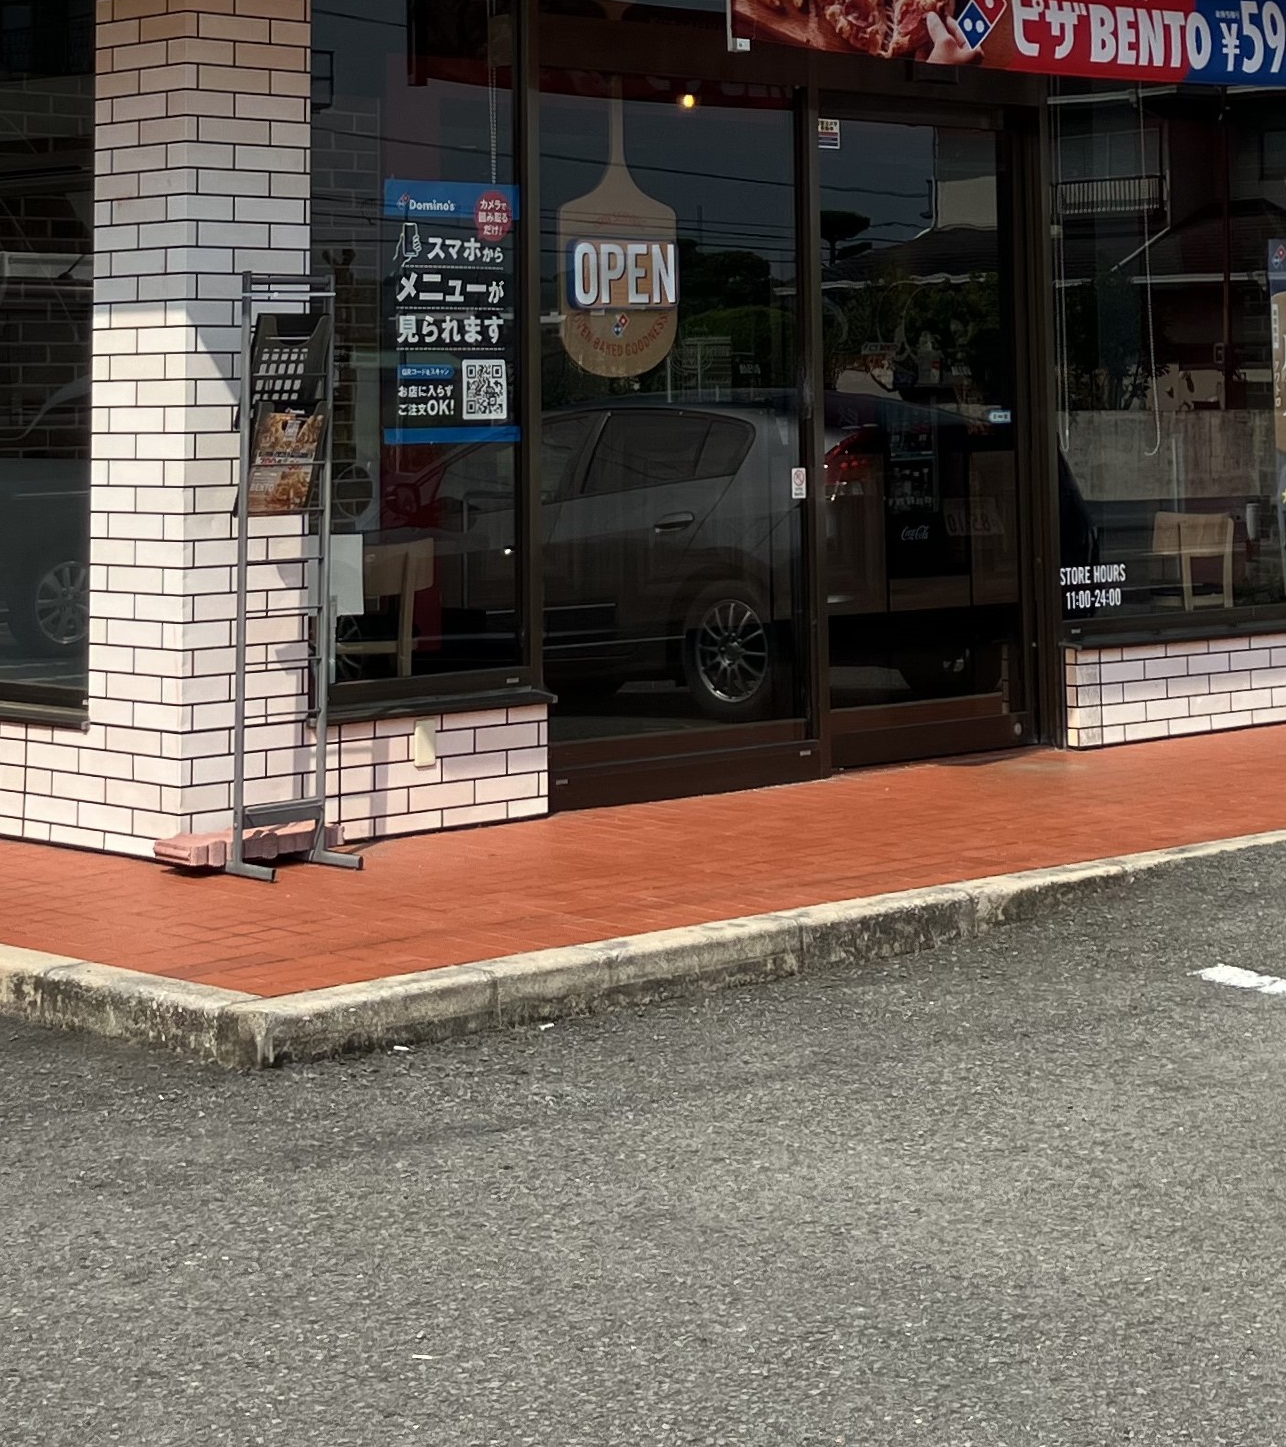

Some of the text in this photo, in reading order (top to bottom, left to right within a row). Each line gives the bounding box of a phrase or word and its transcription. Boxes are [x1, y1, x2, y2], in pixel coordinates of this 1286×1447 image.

[409, 199, 455, 212] Domino's
[426, 236, 504, 263] スマホから
[573, 241, 678, 305] OPEN
[395, 271, 506, 304] メニューが
[395, 314, 505, 344] 見られます
[625, 312, 670, 357] GOODNESS
[397, 384, 454, 398] お店に入らず
[1059, 563, 1127, 586] STORE HOURS
[1065, 587, 1122, 610] 11:00-24:00
